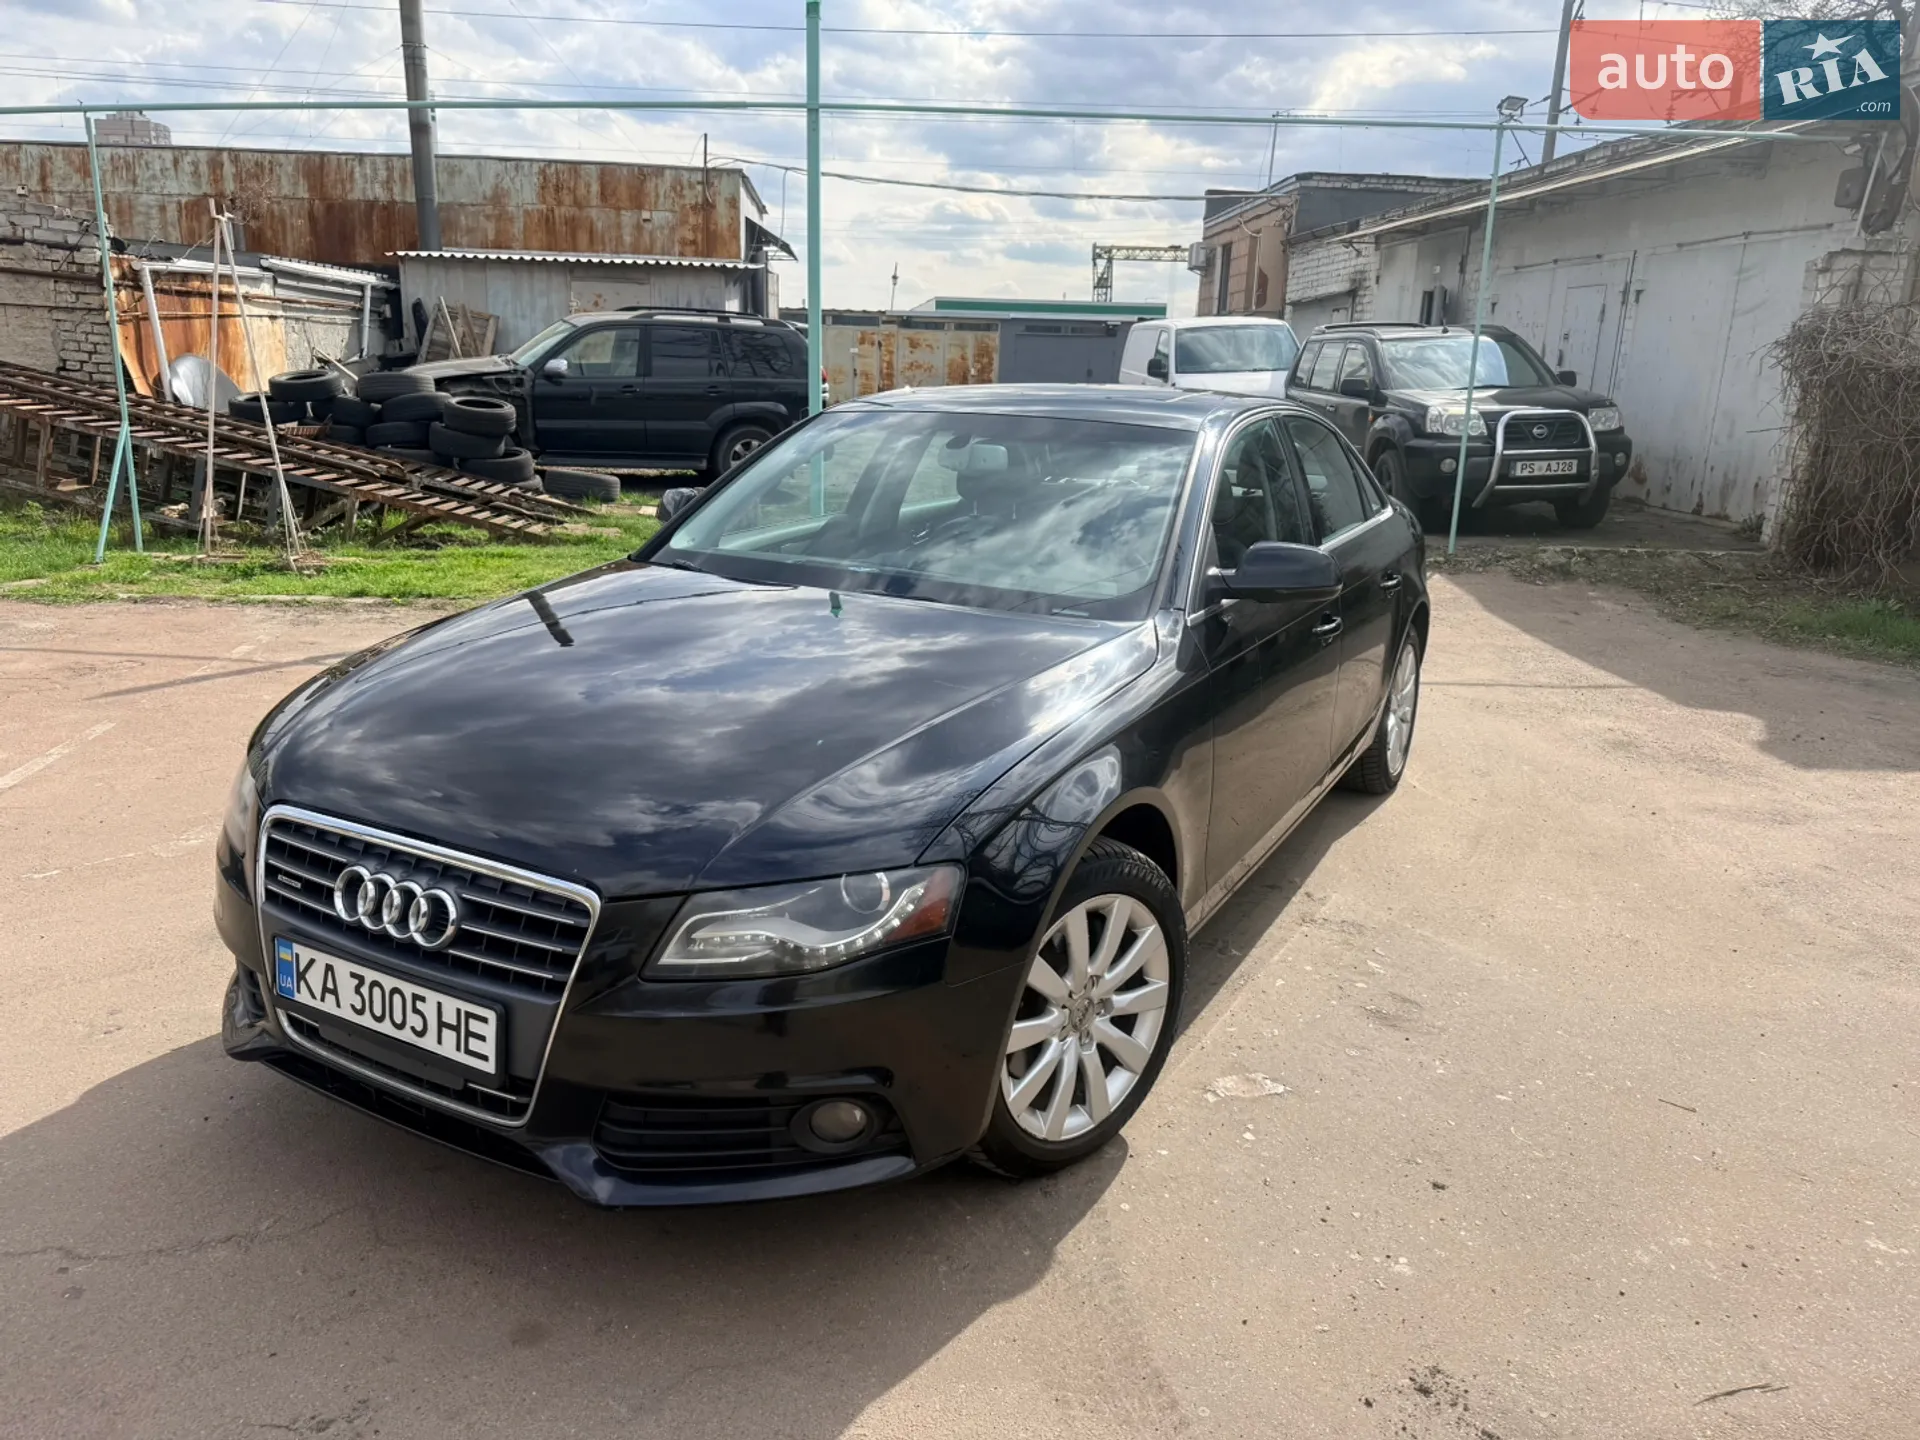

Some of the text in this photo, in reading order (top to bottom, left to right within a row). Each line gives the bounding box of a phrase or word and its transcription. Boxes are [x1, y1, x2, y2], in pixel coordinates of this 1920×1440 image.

[1520, 461, 1573, 474] PS AJ28
[280, 974, 293, 990] UA
[295, 952, 490, 1063] KA 3005 HE
